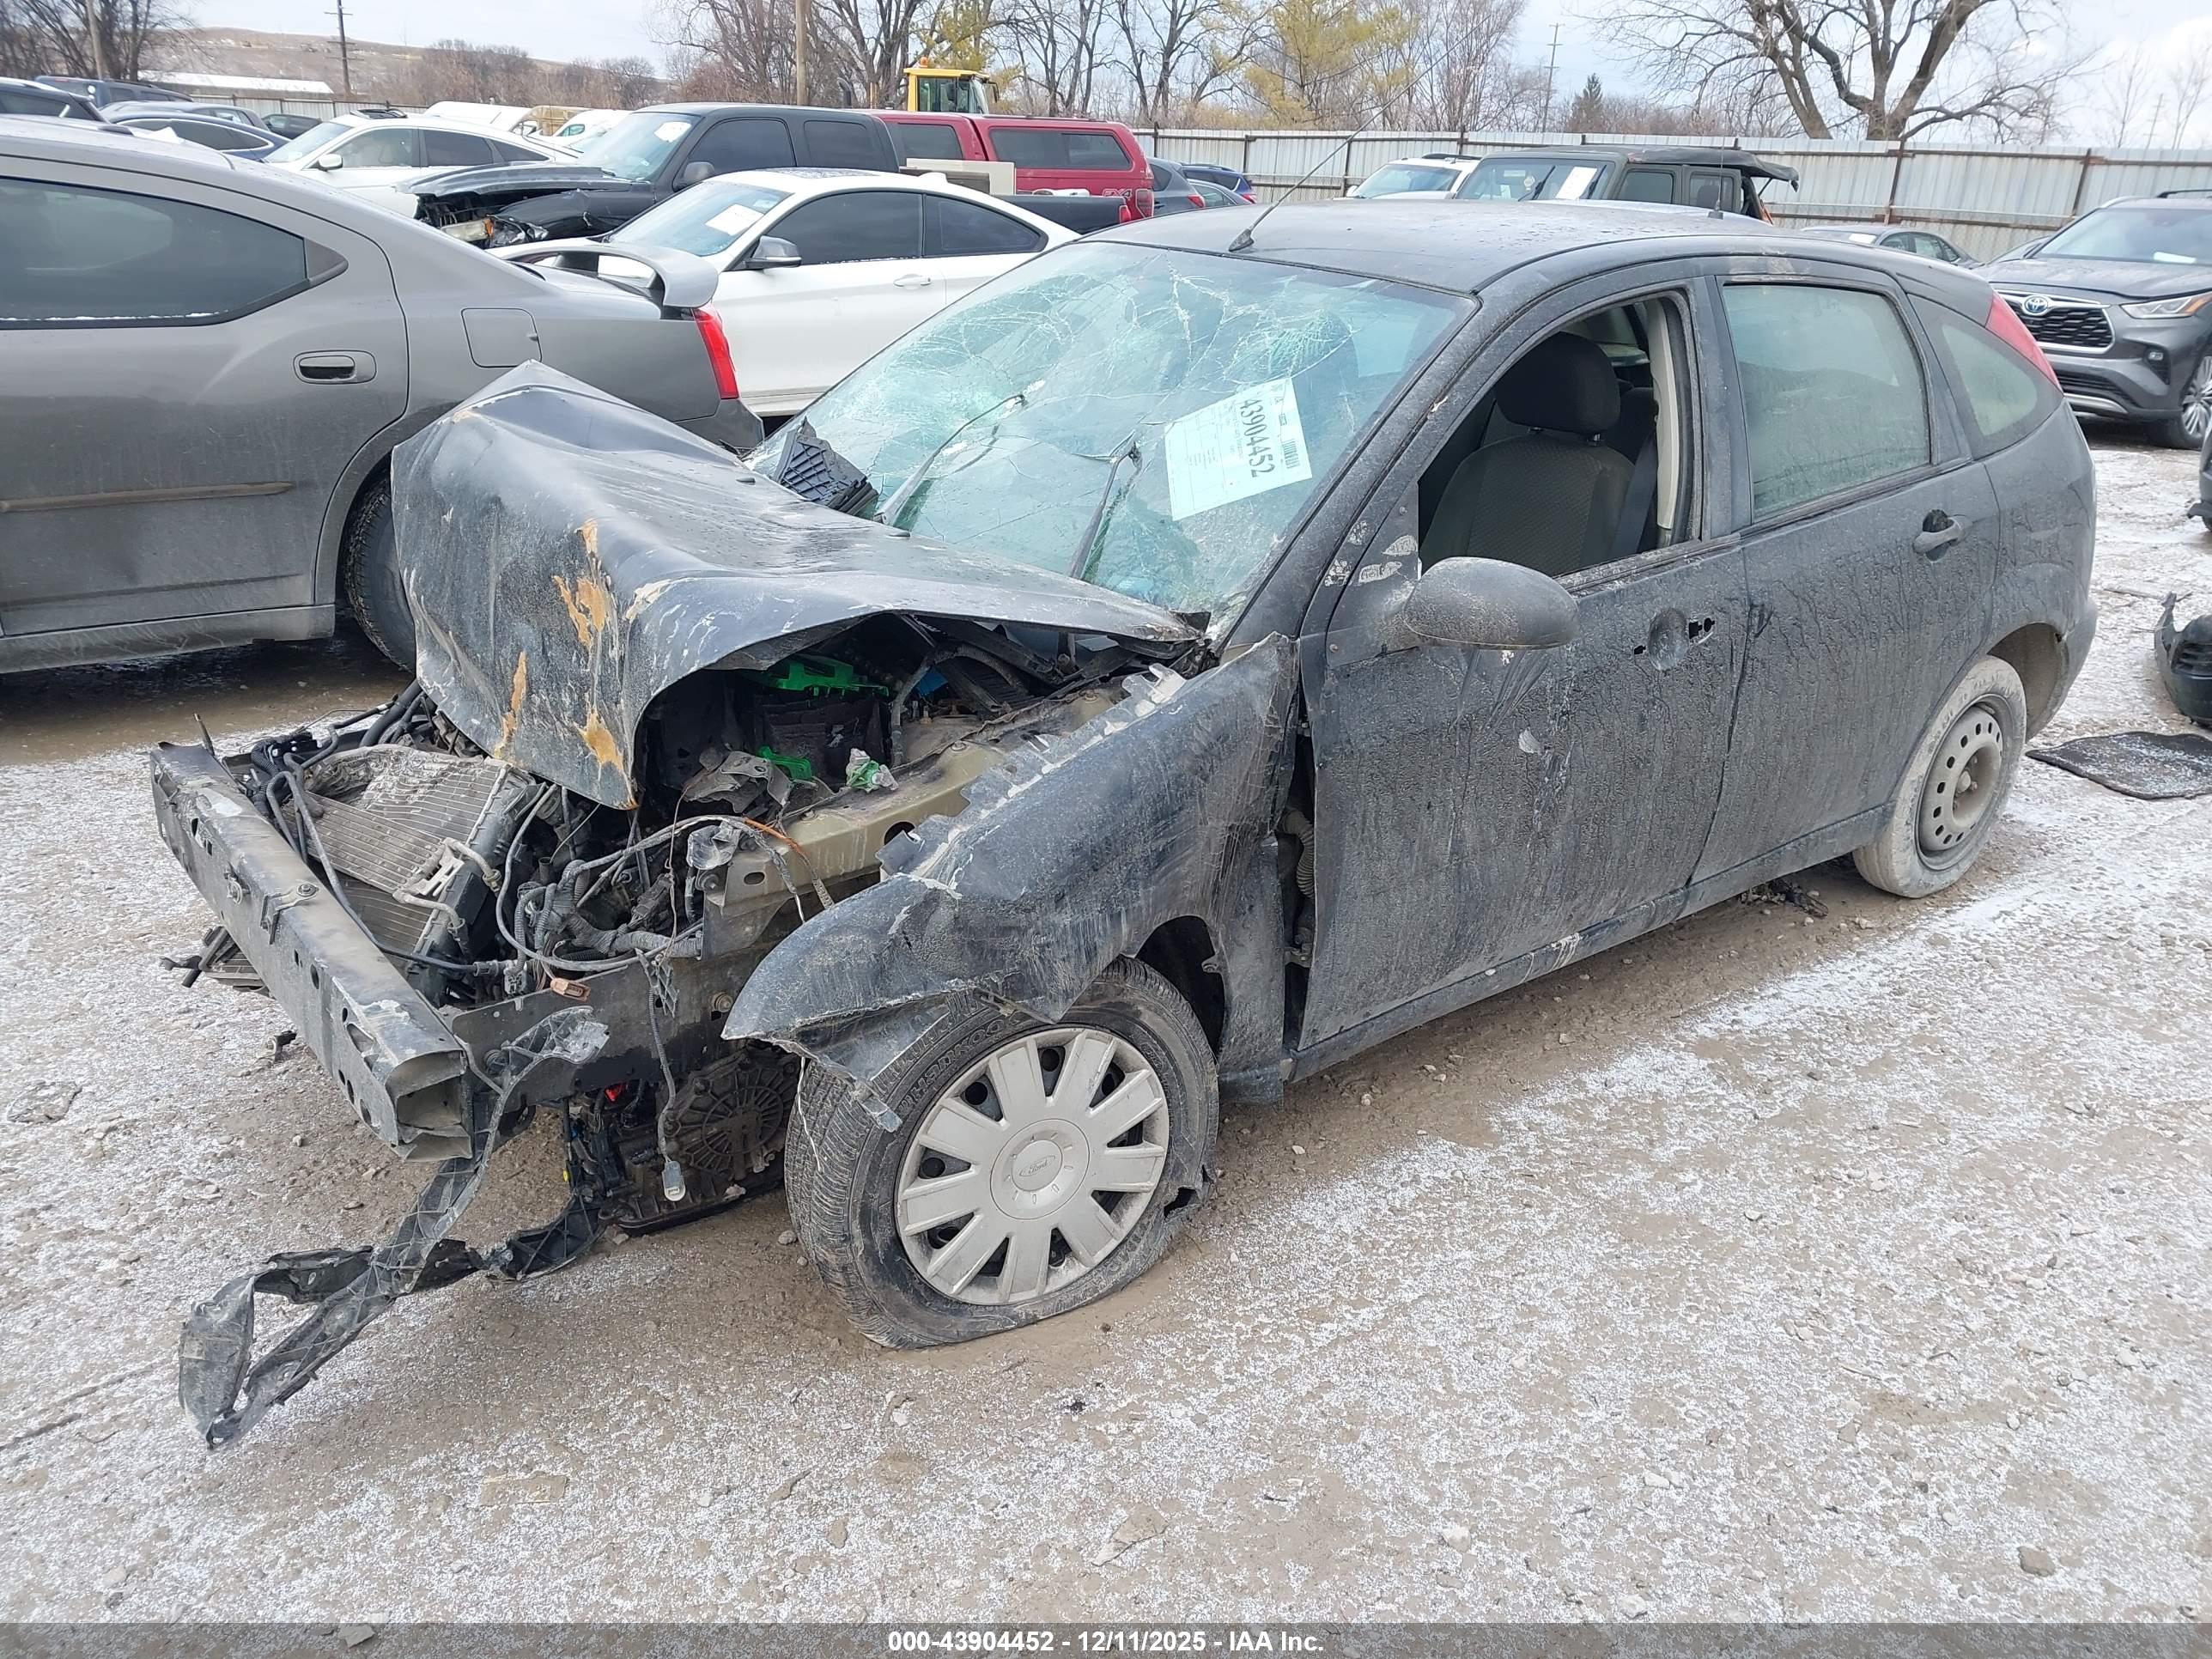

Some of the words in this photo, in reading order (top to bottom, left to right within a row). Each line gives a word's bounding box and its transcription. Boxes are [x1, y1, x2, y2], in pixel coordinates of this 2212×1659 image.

[1103, 188, 1133, 198] FX4
[1239, 398, 1276, 478] 43904452
[1028, 1159, 1049, 1175] Ford
